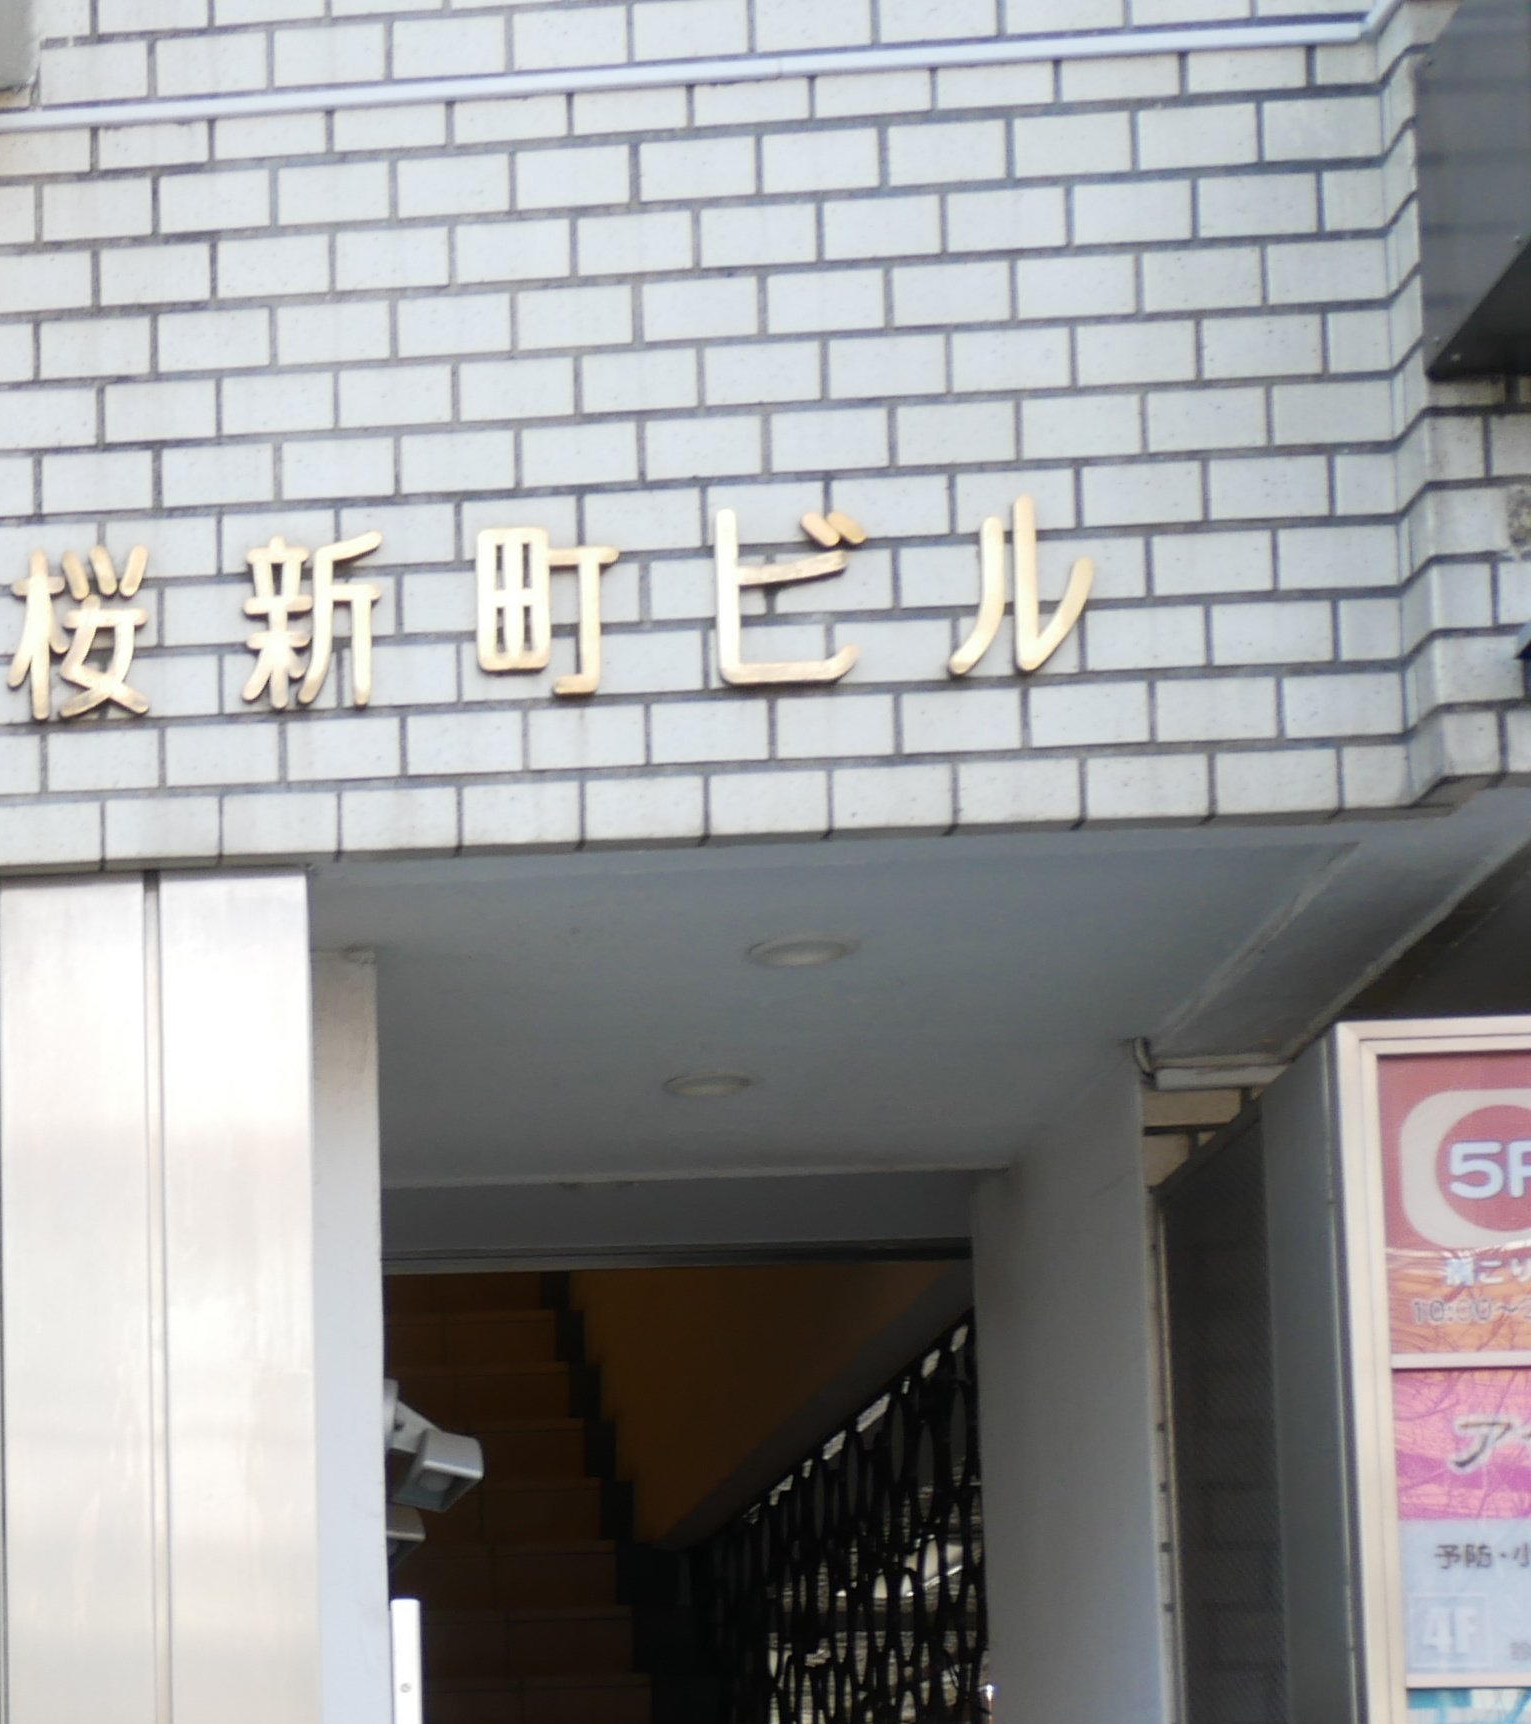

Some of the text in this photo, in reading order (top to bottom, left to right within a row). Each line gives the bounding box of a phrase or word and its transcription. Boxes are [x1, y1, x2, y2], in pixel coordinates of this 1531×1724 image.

[7, 494, 1096, 722] 桜新町ビル
